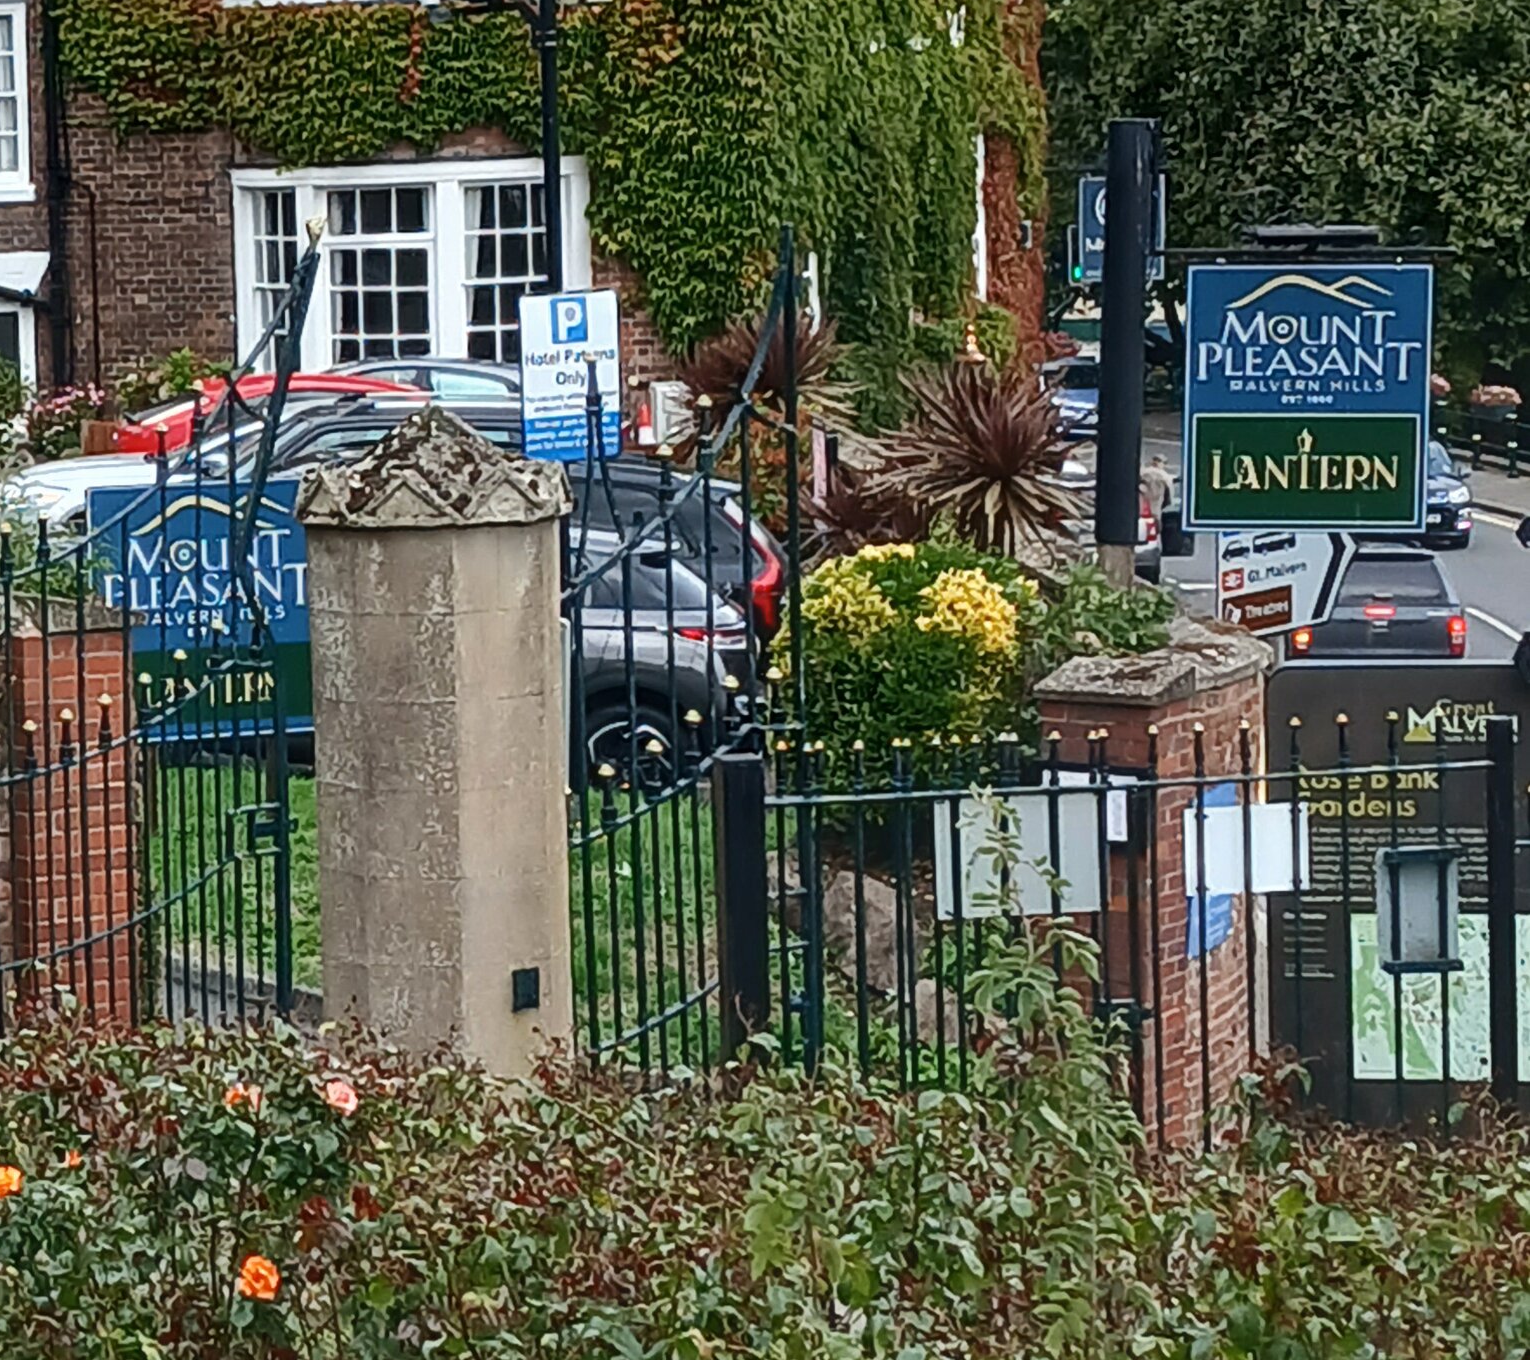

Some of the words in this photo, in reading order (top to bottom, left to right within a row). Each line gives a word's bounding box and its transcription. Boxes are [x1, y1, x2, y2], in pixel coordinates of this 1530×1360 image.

[1220, 311, 1396, 345] MOUNT
[526, 350, 560, 366] Hotel
[565, 349, 615, 363] Patons
[1196, 342, 1422, 381] PLEASANT
[556, 371, 586, 387] Only
[1329, 380, 1386, 392] HILLS
[1211, 448, 1398, 490] LANTERN
[104, 562, 308, 608] PLEASANT
[144, 608, 224, 627] ALVERN
[1407, 706, 1519, 734] MALVE
